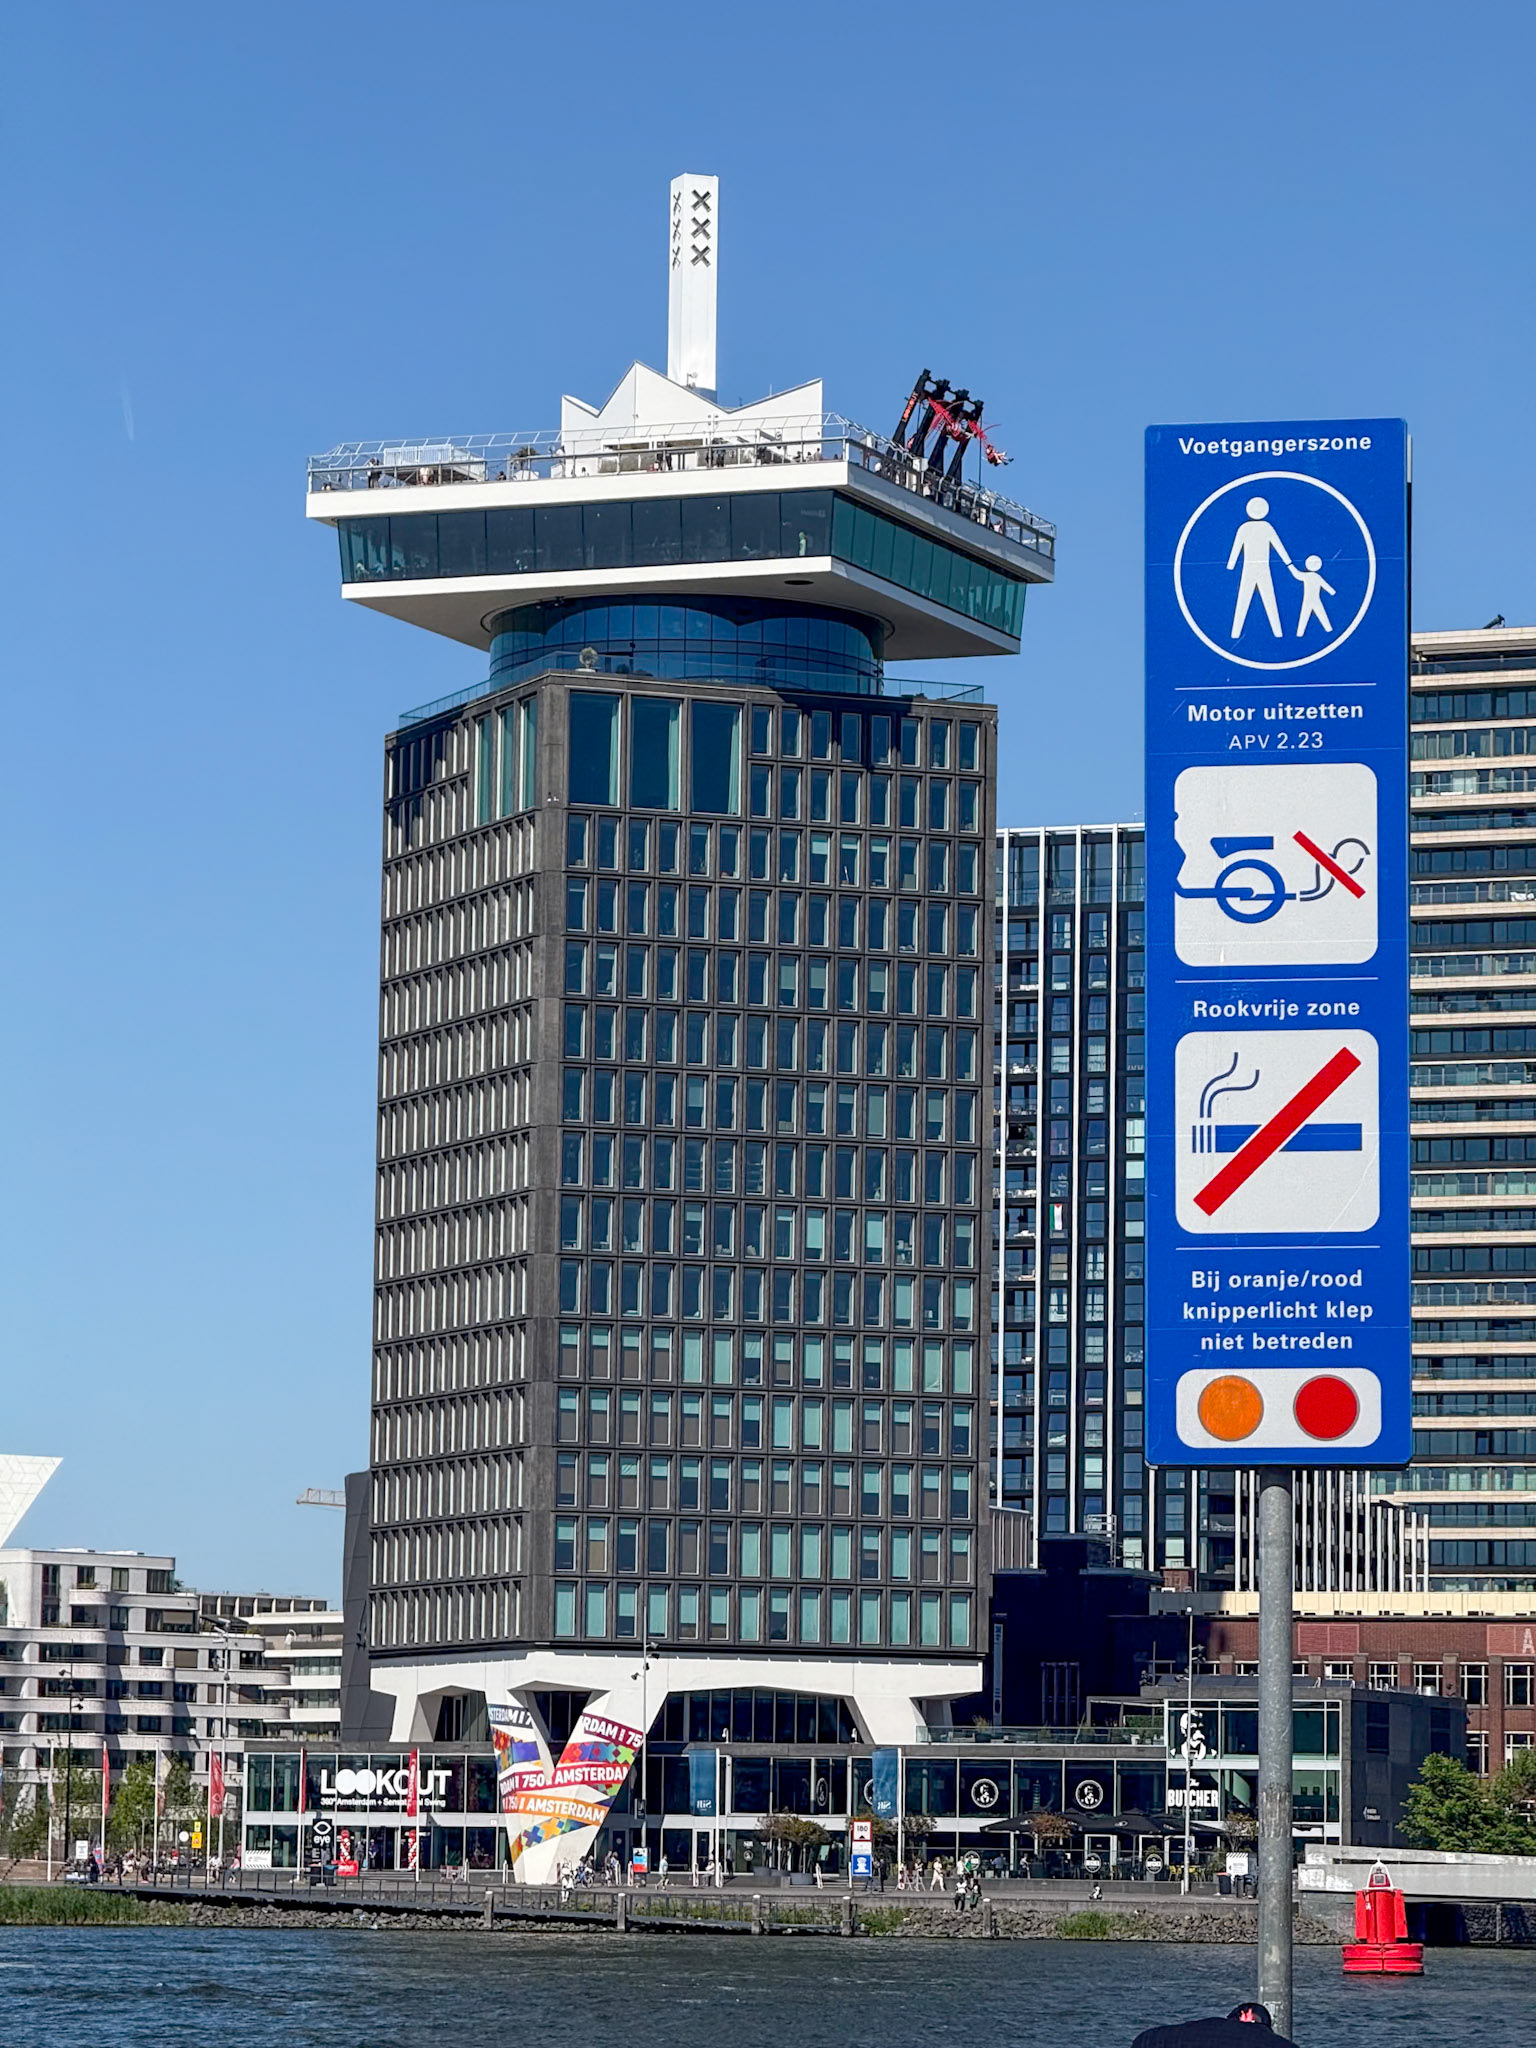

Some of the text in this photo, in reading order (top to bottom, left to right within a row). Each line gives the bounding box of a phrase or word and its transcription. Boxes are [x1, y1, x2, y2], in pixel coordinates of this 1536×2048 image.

[1178, 436, 1372, 458] Voetgangerszone
[1187, 702, 1364, 722] Motor uitzetten
[1228, 731, 1324, 750] APV 2.23
[1193, 999, 1360, 1020] Rookvrije zone
[1191, 1269, 1363, 1292] Bij oranje/rood
[1183, 1300, 1374, 1324] knipperlicht klep
[1201, 1331, 1353, 1351] niet betreden
[320, 1769, 453, 1795] LOOKOUT
[522, 1774, 545, 1788] 750
[337, 1797, 377, 1806] Amsterdam
[424, 1797, 446, 1808] Swing
[1167, 1789, 1219, 1808] BUTCHER
[526, 1797, 606, 1823] AMSTERDAM
[313, 1835, 331, 1846] eye
